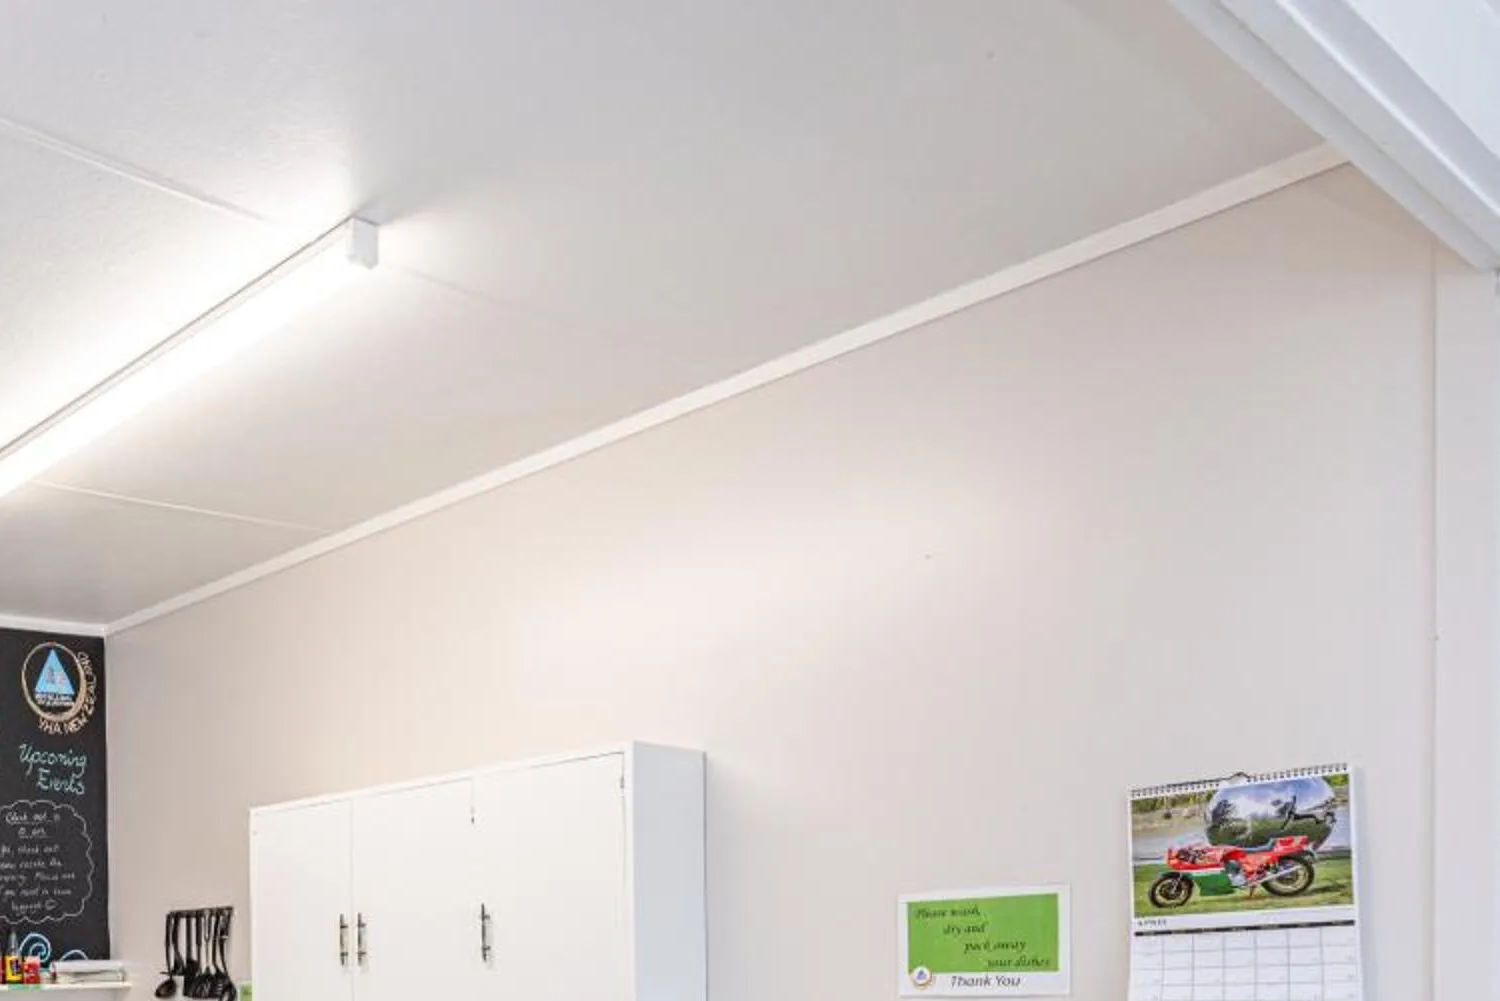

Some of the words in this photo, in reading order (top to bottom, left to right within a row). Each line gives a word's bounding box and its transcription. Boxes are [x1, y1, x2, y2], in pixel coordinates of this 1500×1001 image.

[19, 744, 88, 778] Upcoming
[36, 767, 85, 795] Events
[950, 975, 992, 989] Thank
[995, 975, 1022, 987] You
